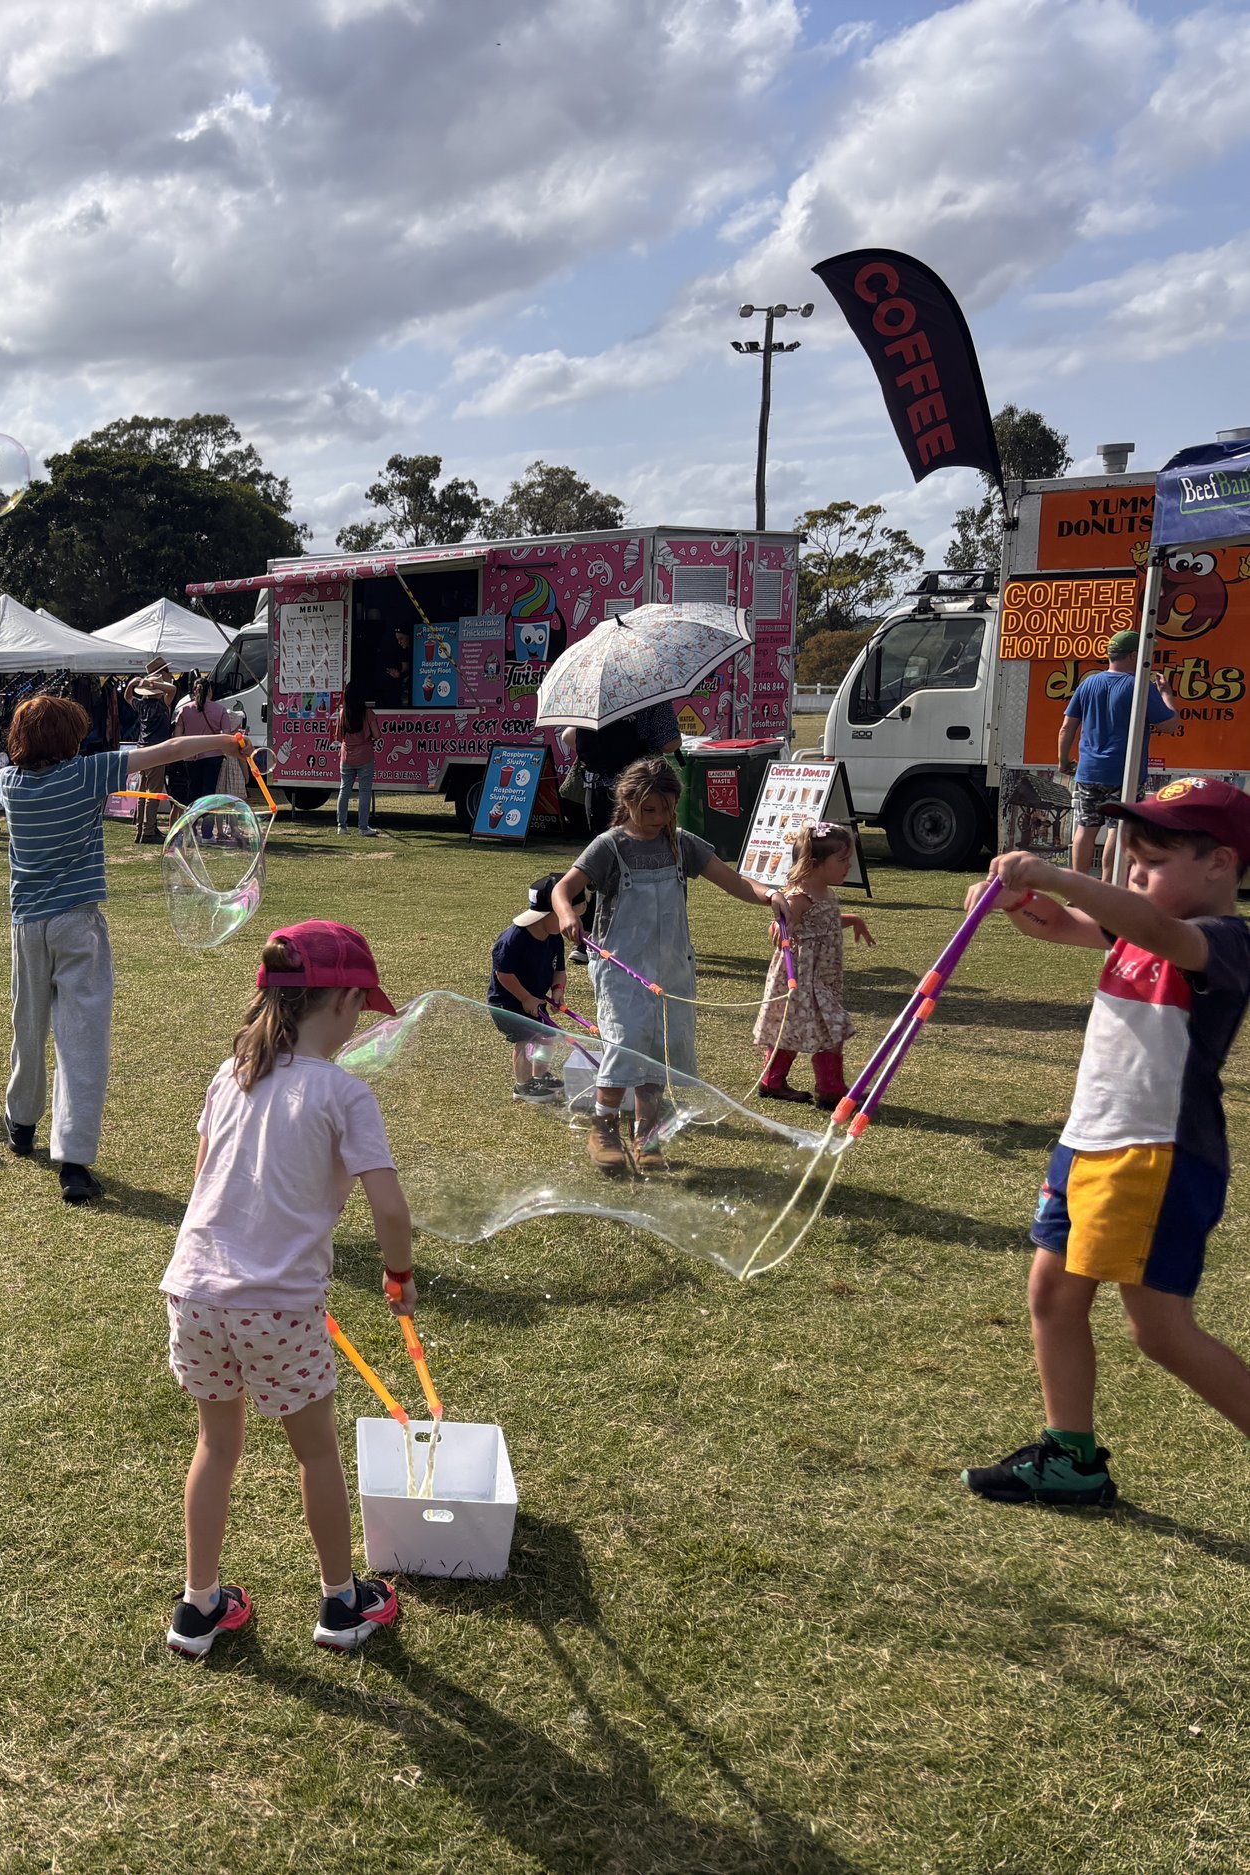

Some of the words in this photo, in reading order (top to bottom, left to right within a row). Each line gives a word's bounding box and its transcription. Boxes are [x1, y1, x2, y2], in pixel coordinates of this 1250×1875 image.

[854, 262, 955, 466] COFFEE
[1088, 496, 1156, 516] YUMM
[1057, 515, 1153, 537] DONUTS
[1004, 580, 1136, 609] COFFEE
[299, 605, 325, 613] MENU
[1001, 607, 1133, 634] DONUTS
[999, 636, 1050, 659] HOT
[1054, 635, 1110, 659] DOG
[504, 661, 547, 688] Twist
[758, 682, 771, 692] 048
[772, 681, 785, 691] 844
[1180, 707, 1235, 721] ONUTS
[283, 721, 300, 733] ICE
[304, 721, 330, 733] CRE
[381, 720, 441, 734] SUNDAES
[471, 719, 499, 735] SOFT
[501, 718, 535, 736] SERVE
[502, 751, 534, 759] Raspberry
[280, 769, 333, 777] twistedsoftserve
[378, 771, 392, 779] FOR
[394, 771, 421, 779] EVENTS
[516, 773, 527, 782] $6
[493, 786, 526, 796] Raspberry
[489, 793, 509, 803] Slushy
[510, 795, 526, 803] Float
